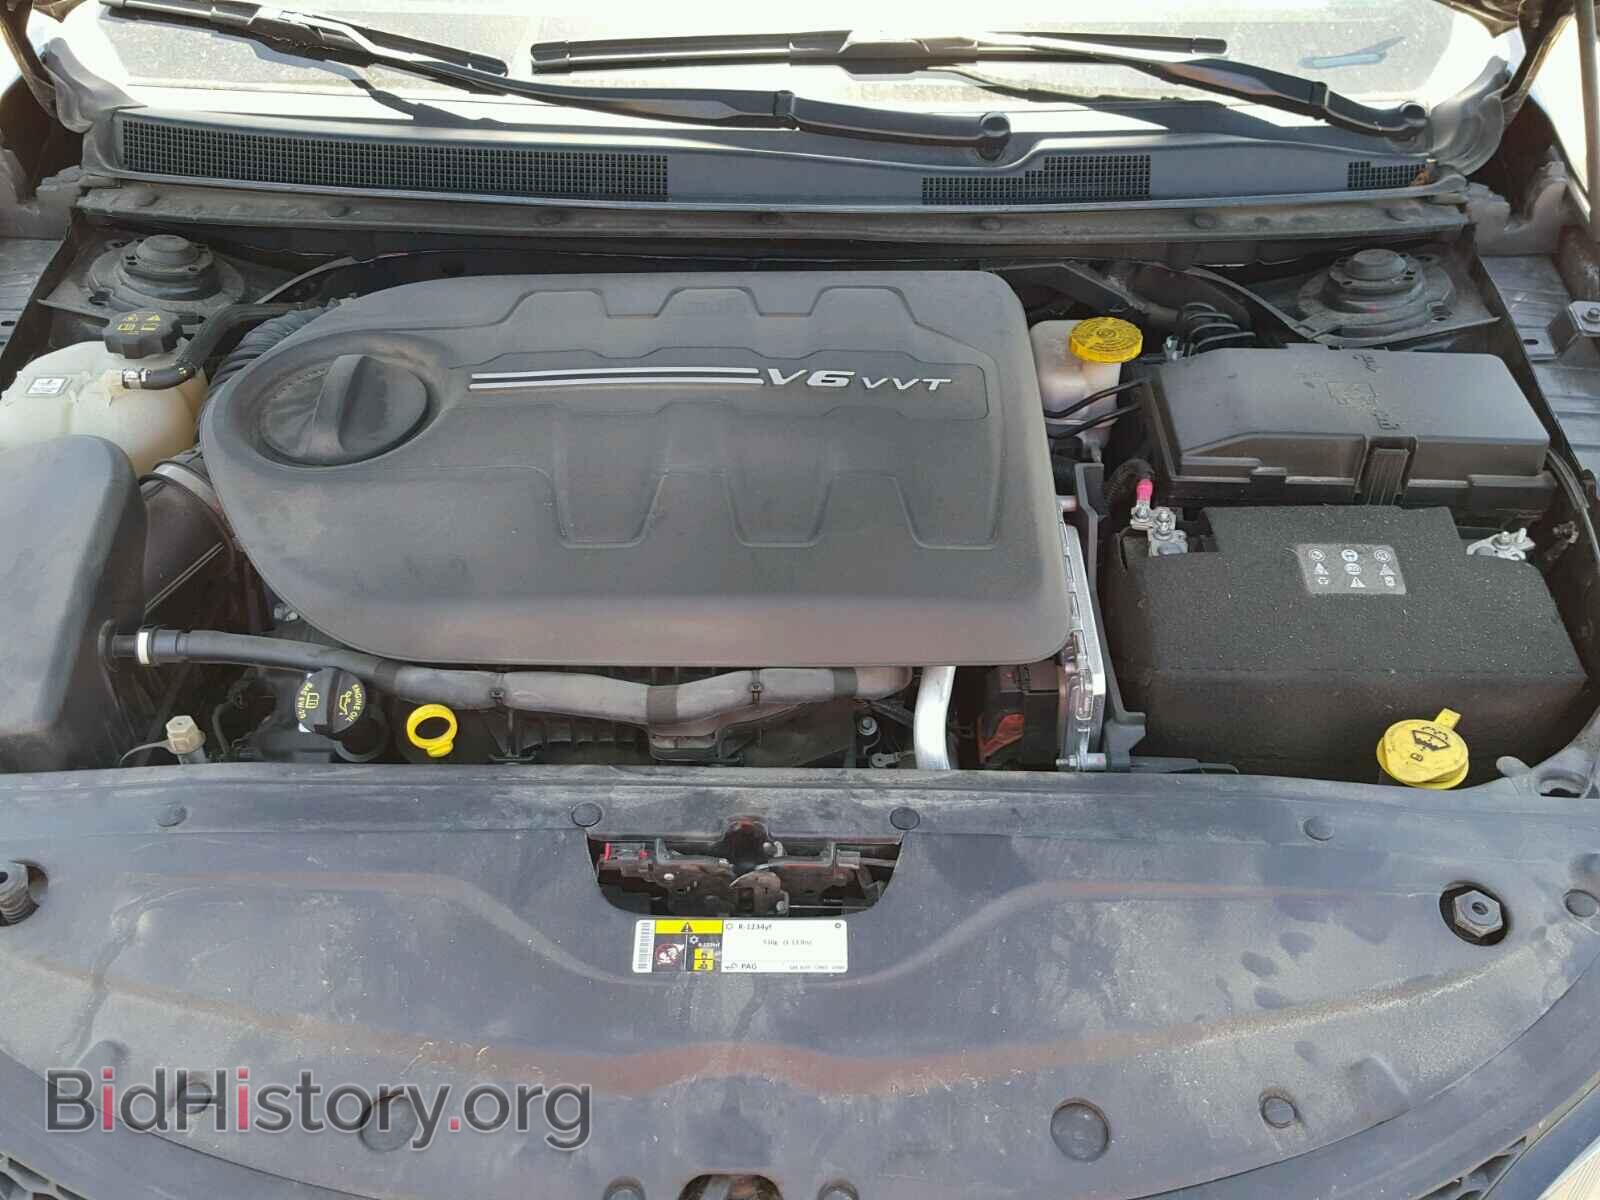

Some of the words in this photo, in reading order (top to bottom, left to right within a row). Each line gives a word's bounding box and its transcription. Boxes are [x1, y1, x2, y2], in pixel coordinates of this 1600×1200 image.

[767, 368, 856, 388] V6
[861, 376, 952, 391] VVT
[351, 683, 363, 711] ENGINE
[345, 711, 359, 722] OIL
